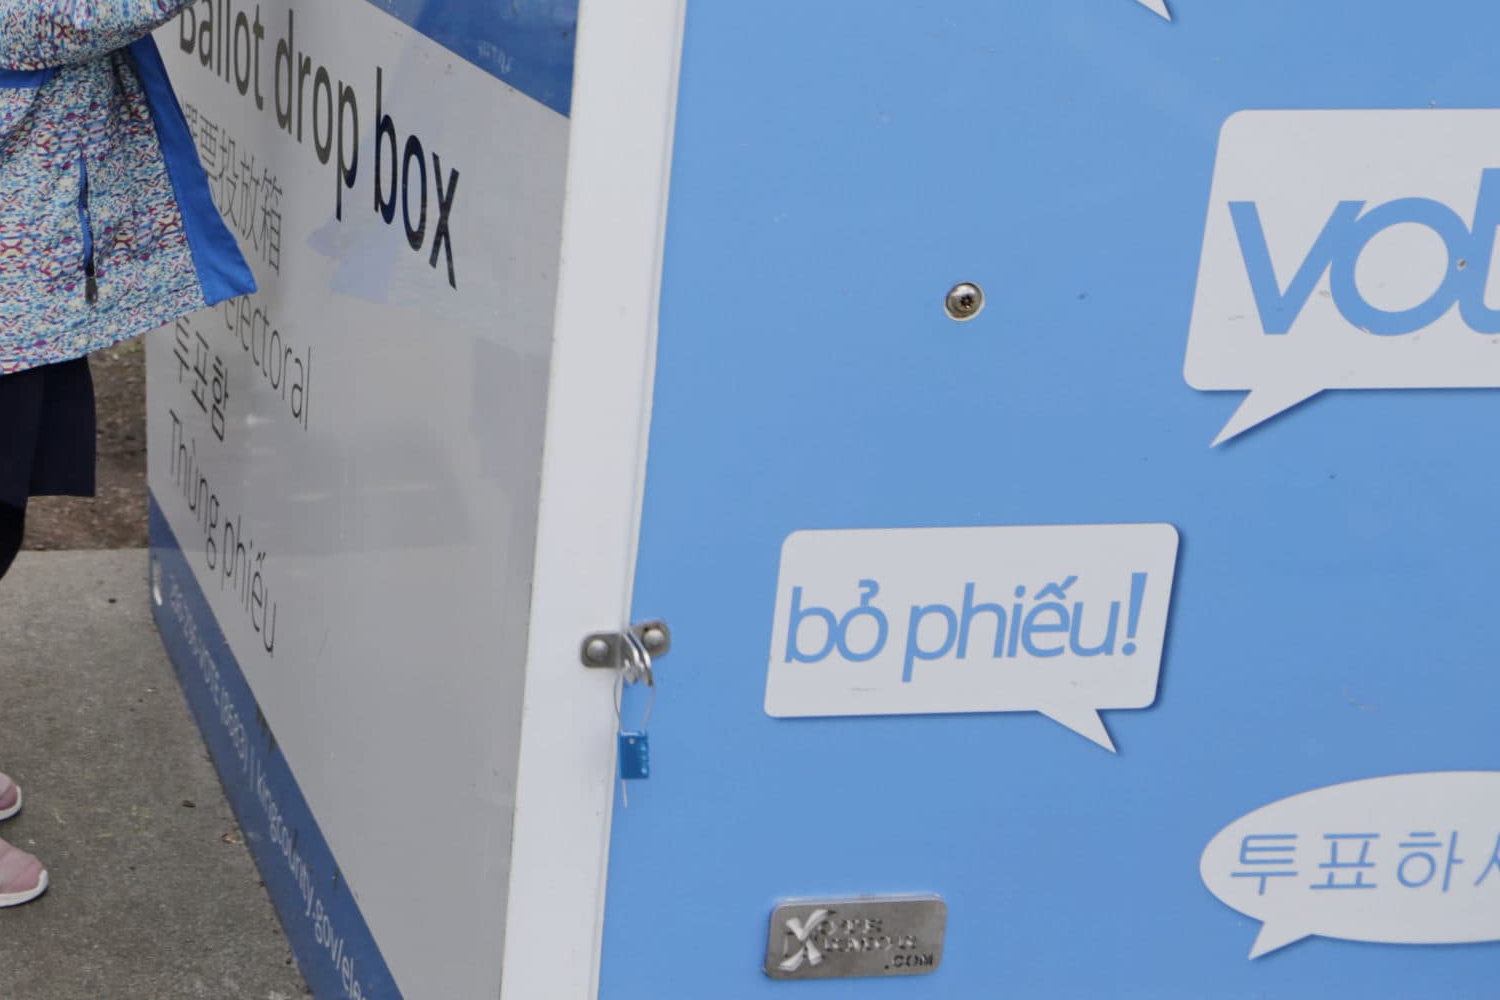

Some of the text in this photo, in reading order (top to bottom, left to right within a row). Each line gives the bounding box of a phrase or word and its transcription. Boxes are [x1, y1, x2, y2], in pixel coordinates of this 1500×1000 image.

[275, 8, 359, 222] drop
[374, 66, 459, 291] box
[169, 409, 219, 570] Thùng
[784, 572, 1148, 683] bỏ phiếu!
[256, 759, 367, 1000] kingcounty.gov/ele
